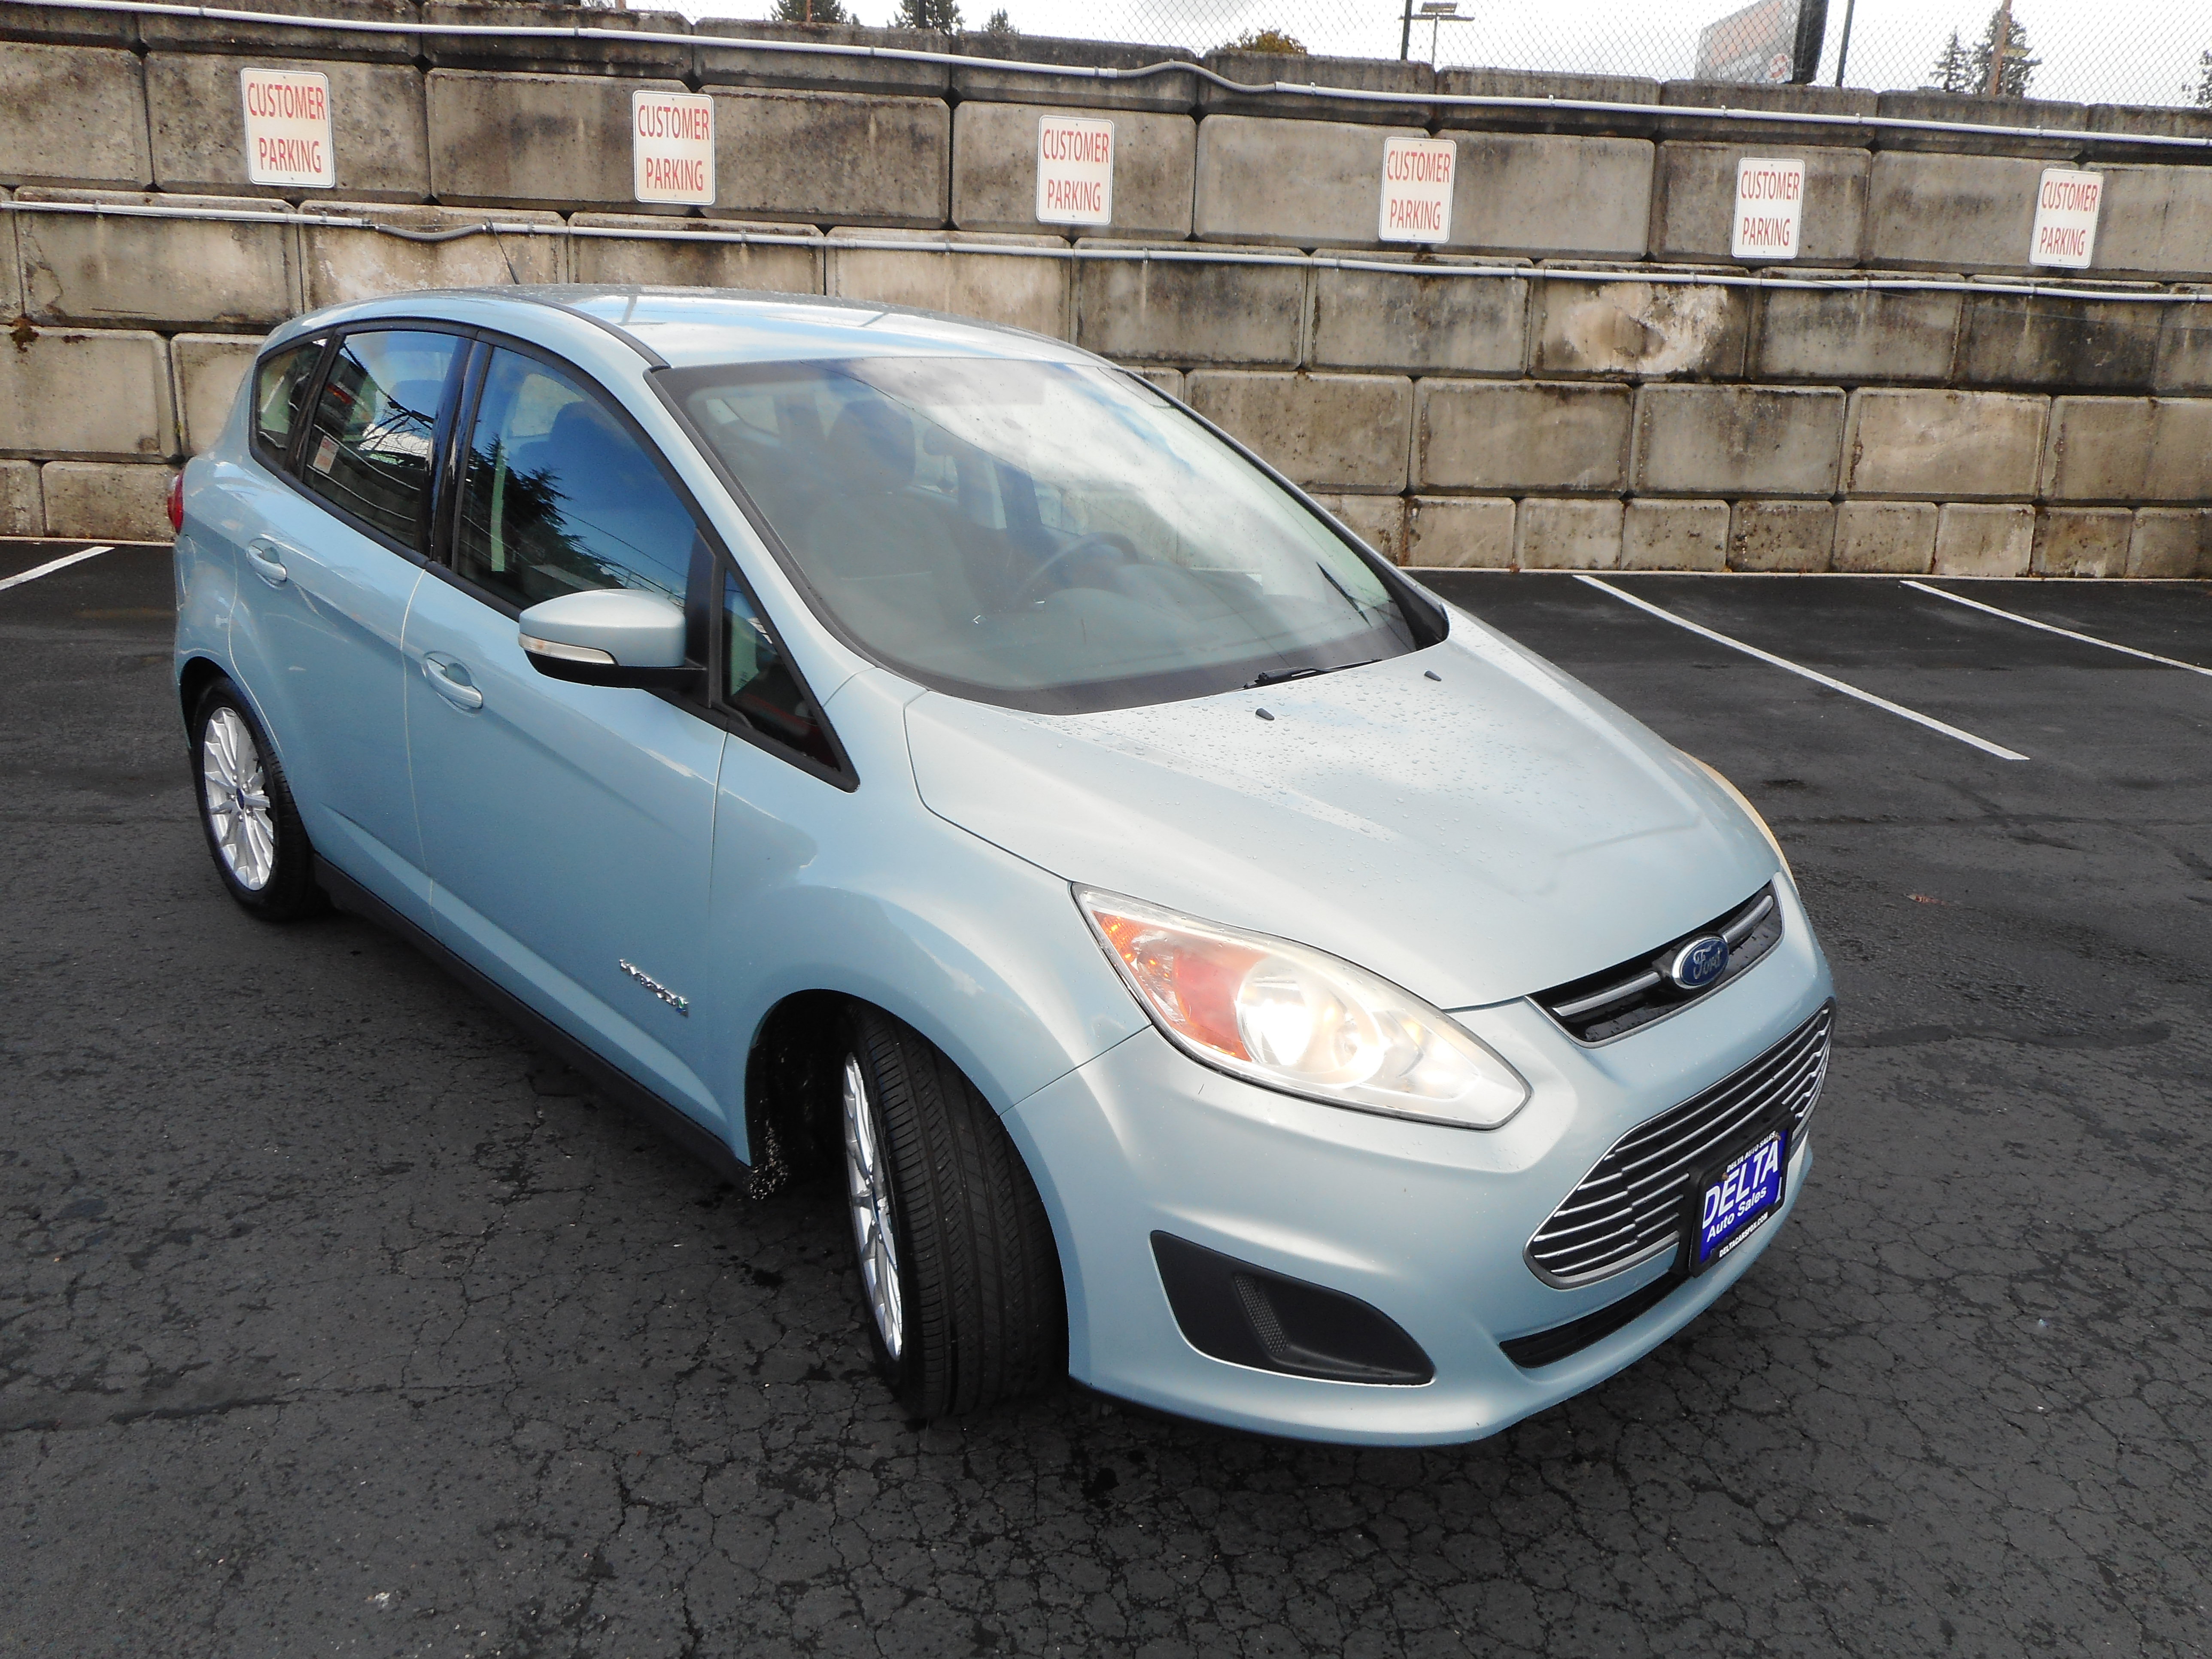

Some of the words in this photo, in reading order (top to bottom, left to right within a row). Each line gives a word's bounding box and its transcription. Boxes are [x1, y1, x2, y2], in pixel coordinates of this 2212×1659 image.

[248, 82, 325, 120] CUSTOMER
[638, 105, 709, 140] CUSTOMER
[259, 137, 322, 173] PARKING
[1043, 129, 1109, 163] CUSTOMER
[646, 157, 703, 191] PARKING
[1387, 151, 1450, 182] CUSTOMER
[1047, 179, 1100, 211] PARKING
[1741, 170, 1799, 201] CUSTOMER
[2042, 181, 2098, 212] CUSTOMER
[1390, 199, 1441, 230] PARKING
[1742, 217, 1790, 246] PARKING
[2039, 227, 2086, 256] PARKING
[1693, 945, 1722, 979] Ford
[1726, 1155, 1743, 1173] DELTA
[1744, 1144, 1759, 1160] AUTO
[1702, 1139, 1778, 1229] DELTA
[1707, 1212, 1735, 1243] Auto
[1737, 1186, 1767, 1217] Sales
